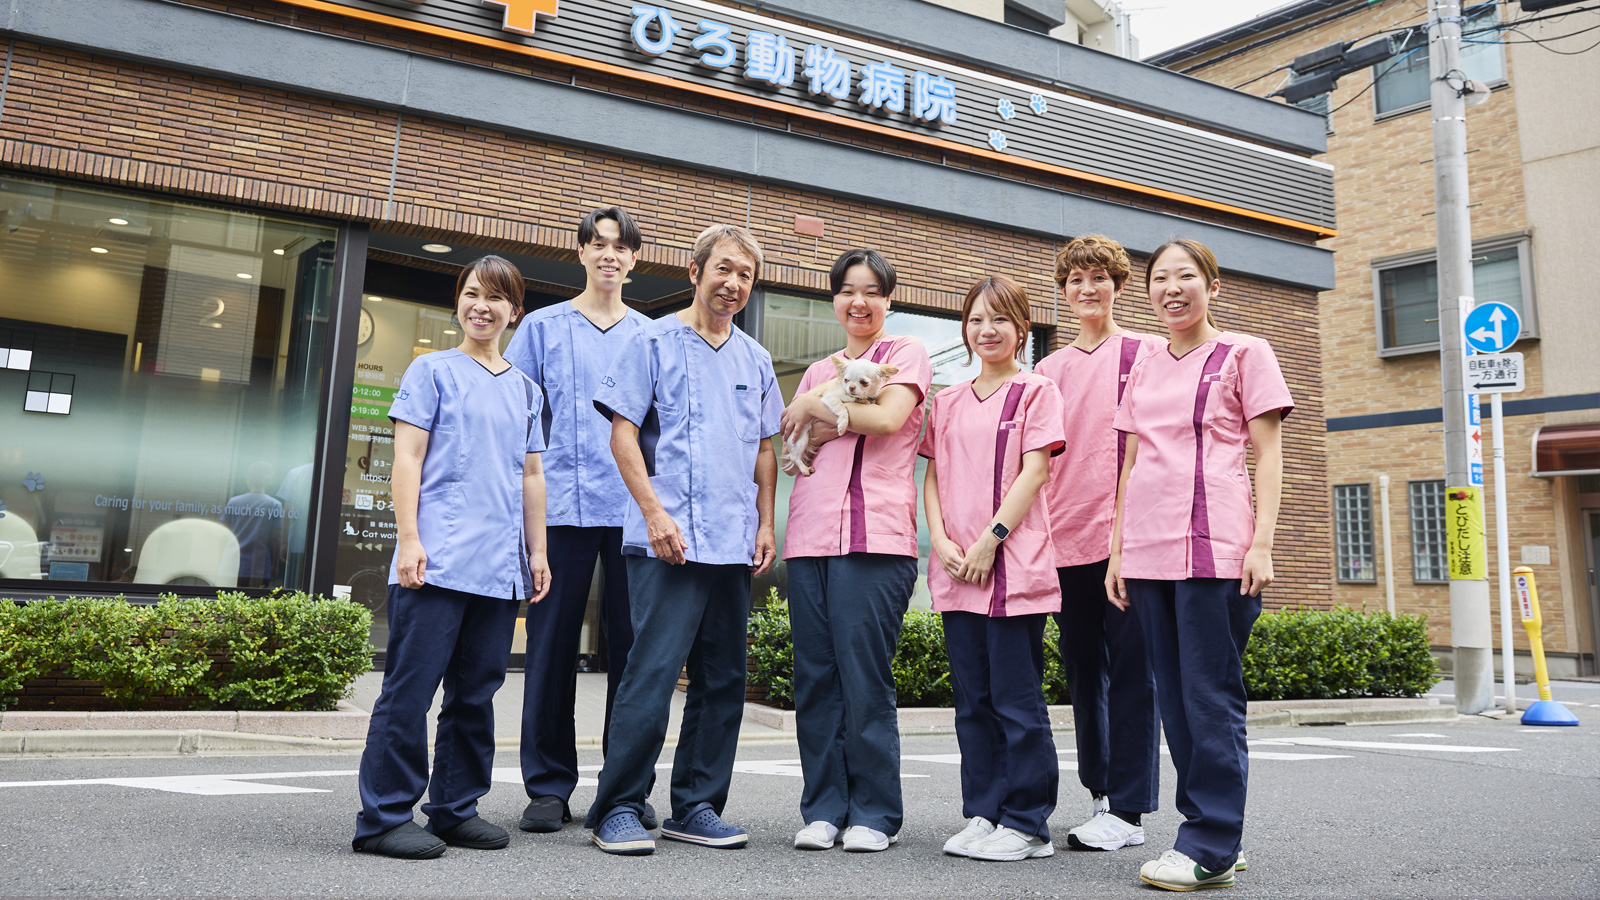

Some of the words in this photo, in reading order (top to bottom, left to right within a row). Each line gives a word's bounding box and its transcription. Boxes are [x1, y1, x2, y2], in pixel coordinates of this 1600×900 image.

[631, 5, 957, 125] ひろ動物病院
[358, 363, 383, 372] HOURS
[1469, 358, 1517, 370] 自転車を除く
[1469, 369, 1517, 380] 一方通行
[352, 424, 367, 432] WEB
[369, 425, 382, 434] 予約
[382, 427, 393, 435] OK
[94, 494, 128, 511] Caring
[131, 496, 147, 509] for
[149, 500, 173, 512] your
[175, 499, 208, 515] family,
[210, 504, 222, 514] as
[224, 504, 251, 516] much
[254, 508, 265, 517] as
[268, 508, 284, 520] you
[287, 508, 299, 519] do
[362, 530, 378, 538] Cat
[1456, 503, 1472, 575] とびだし注意
